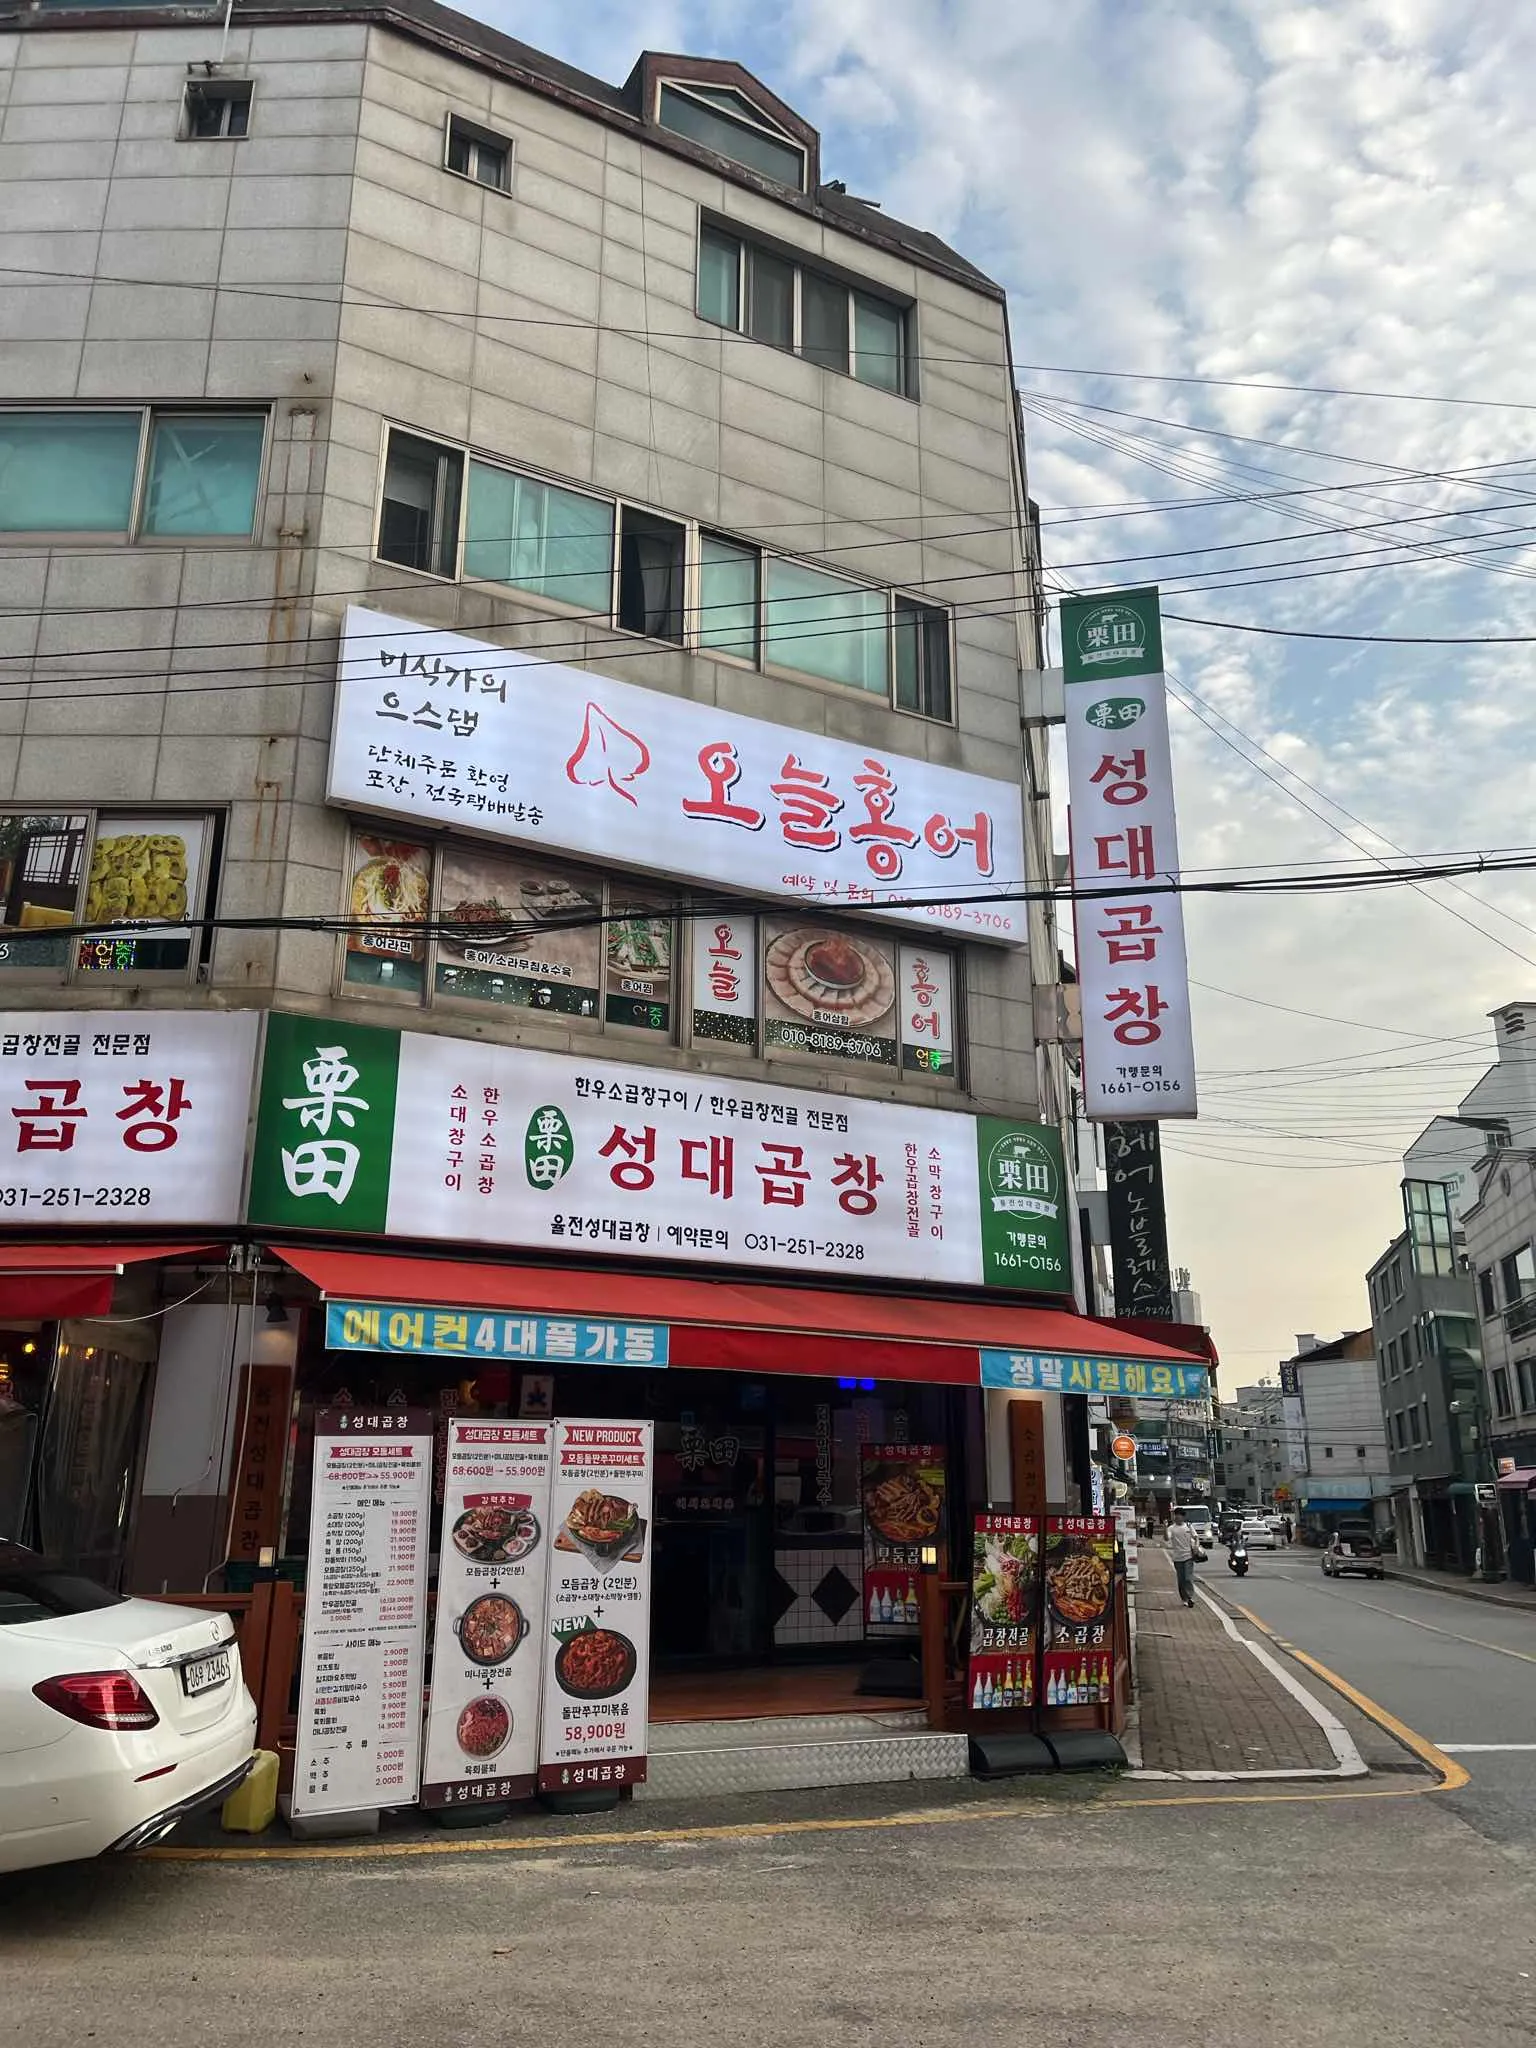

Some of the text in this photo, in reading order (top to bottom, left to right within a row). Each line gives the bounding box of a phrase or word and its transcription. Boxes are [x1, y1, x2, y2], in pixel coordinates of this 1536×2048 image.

[1087, 621, 1136, 648] 栗田
[381, 650, 507, 702] 미식가의
[375, 691, 480, 736] 으스댐
[1091, 703, 1142, 728] 栗田
[368, 745, 509, 793] 단체주문 환영
[365, 769, 544, 825] 포장, 전국택배발송
[682, 740, 995, 881] 오늘홍어
[782, 873, 816, 891] 예약
[824, 879, 840, 898] 및
[847, 883, 875, 903] 문의
[1089, 749, 1170, 1045] 성대곱창
[708, 923, 743, 1001] 오늘
[911, 958, 941, 1040] 홍어
[2, 1034, 151, 1056] 곱창전골 전문점
[781, 1027, 882, 1058] 010-8189-3706
[1115, 1065, 1163, 1079] 가맹문의
[1100, 1079, 1181, 1095] 1661-0156
[11, 1078, 193, 1153] 곱창
[575, 1077, 688, 1110] 한우소곱창구이
[710, 1096, 799, 1126] 한우곱창전골
[806, 1109, 849, 1132] 전문점
[281, 1046, 370, 1205] 栗田
[444, 1084, 468, 1192] 소대창구이
[477, 1087, 501, 1194] 한우소곱창
[529, 1110, 569, 1184] 栗田
[598, 1125, 885, 1216] 성대곱창
[997, 1157, 1051, 1194] 栗田
[0, 1187, 151, 1207] 31-251-2328
[903, 1142, 921, 1239] 한우곱창전골
[928, 1147, 945, 1241] 소막창구이
[550, 1214, 865, 1261] 율전성대곱창 예약문의 031-251-2328
[1006, 1230, 1047, 1249] 가맹문의
[994, 1251, 1062, 1272] 1661-0156
[352, 1415, 409, 1429] 성대곱창
[464, 1428, 501, 1441] 성대곱창
[572, 1430, 637, 1444] NEW PRODUCT
[993, 1516, 1033, 1529] 성대곱창
[1066, 1517, 1105, 1530] 성대곱창
[879, 1547, 921, 1563] 모듬곱
[560, 1576, 638, 1591] 모듬곱창 (2인분)
[551, 1614, 588, 1633] NEW
[1055, 1624, 1106, 1645] 소곱창
[982, 1627, 1029, 1648] 곱창전골
[562, 1702, 630, 1721] 돌판쭈꾸미볶음
[565, 1721, 626, 1743] 58,900원
[572, 1763, 627, 1784] 성대곱창
[456, 1781, 512, 1801] 성대곱창
